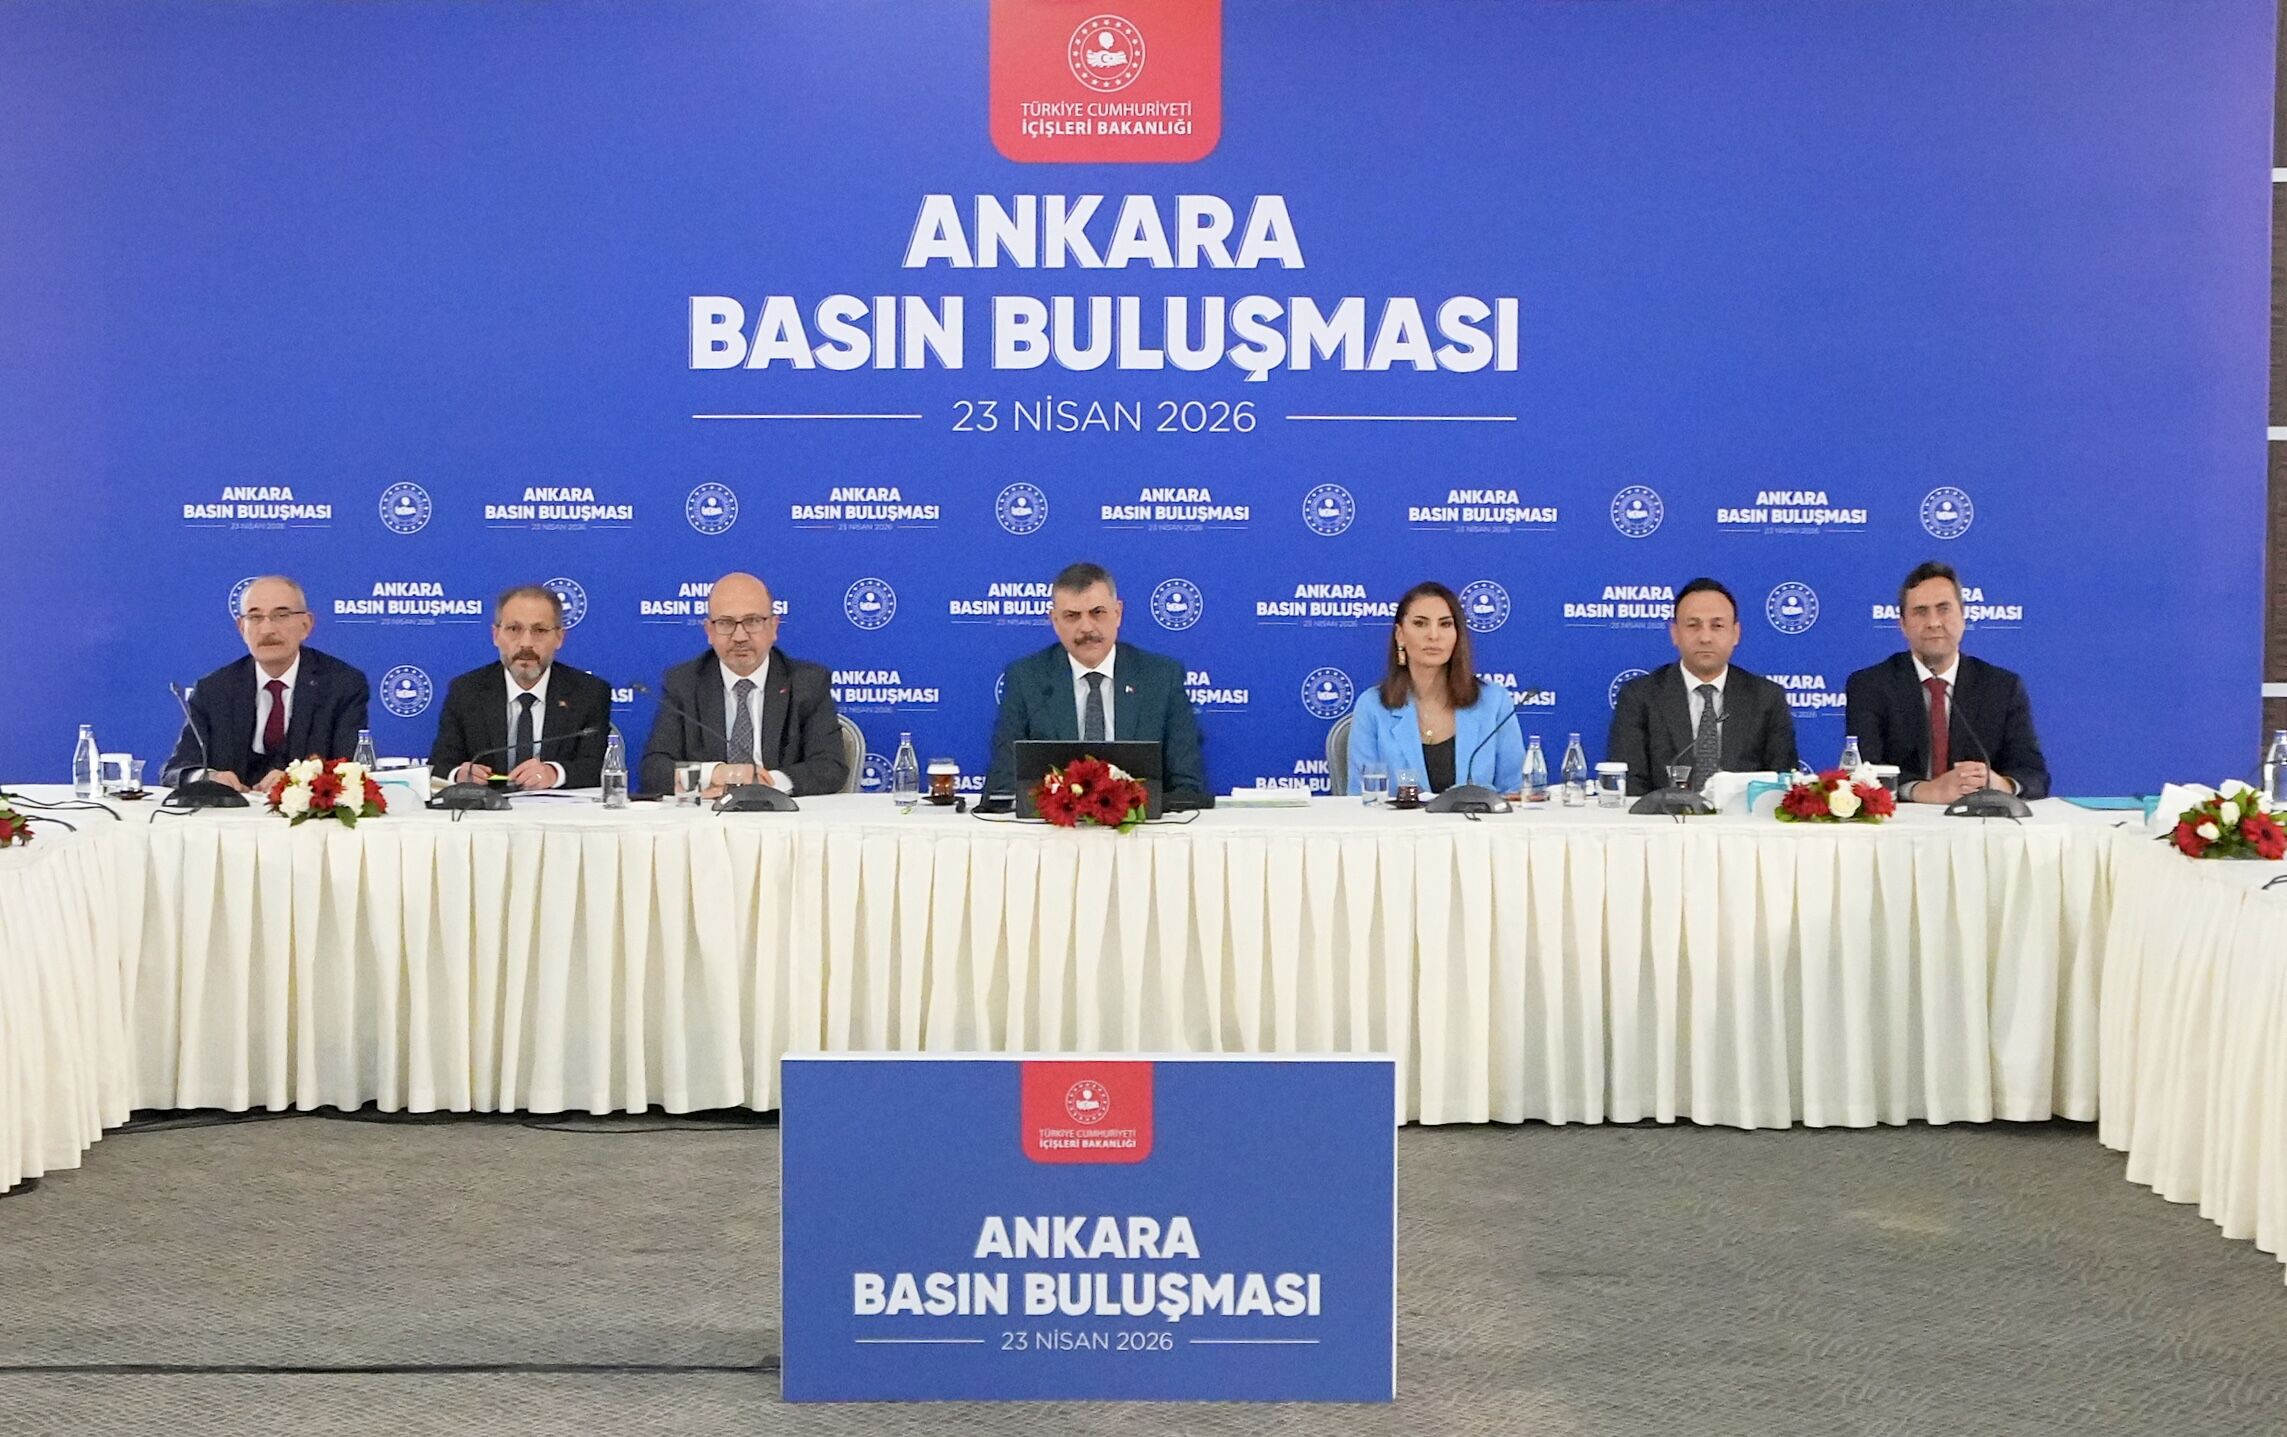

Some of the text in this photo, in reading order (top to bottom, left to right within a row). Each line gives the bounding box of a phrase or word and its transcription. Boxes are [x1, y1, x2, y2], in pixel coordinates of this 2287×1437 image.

[1020, 101, 1192, 116] TÜRKİYE CUMHURİYETİ
[1022, 119, 1192, 138] İÇİŞLERİ BAKANLIĞI
[902, 195, 1305, 268] ANKARA
[689, 295, 1518, 381] BASIN BULUŞMASI
[952, 396, 1256, 433] 23 NİSAN 2026
[222, 487, 293, 500] ANKARA
[523, 488, 594, 501] ANKARA
[830, 488, 901, 501] ANKARA
[1140, 488, 1211, 502] ANKARA
[1448, 490, 1519, 504] ANKARA
[1756, 491, 1828, 505] ANKARA
[184, 505, 331, 520] BASIN BULUŞMASI
[485, 505, 632, 521] BASIN BULUŞMASI
[792, 506, 939, 521] BASIN BULUŞMASI
[1102, 506, 1249, 522] BASIN BULUŞMASI
[1409, 507, 1557, 523] BASIN BULUŞMASI
[1718, 509, 1866, 525] BASIN BULUŞMASI
[373, 583, 443, 596] ANKARA
[1295, 585, 1366, 599] ANKARA
[1602, 586, 1674, 600] ANKARA
[335, 600, 482, 616] BASIN BULUŞMASI
[641, 601, 690, 615] BASIN
[950, 601, 999, 615] BASIN
[1257, 602, 1399, 618] BASIN BULUŞMAS
[1564, 604, 1672, 620] BASIN BULUŞ
[831, 670, 901, 685] ANKARA
[845, 688, 939, 704] BULUŞMASI
[1294, 760, 1329, 774] ANK
[1039, 1138, 1137, 1149] İÇİŞLERİ BAKANLIĞI
[973, 1216, 1200, 1259] ANKARA
[853, 1272, 1320, 1322] BASIN BULUŞMASI
[1001, 1328, 1174, 1351] 23 NİSAN 2026
